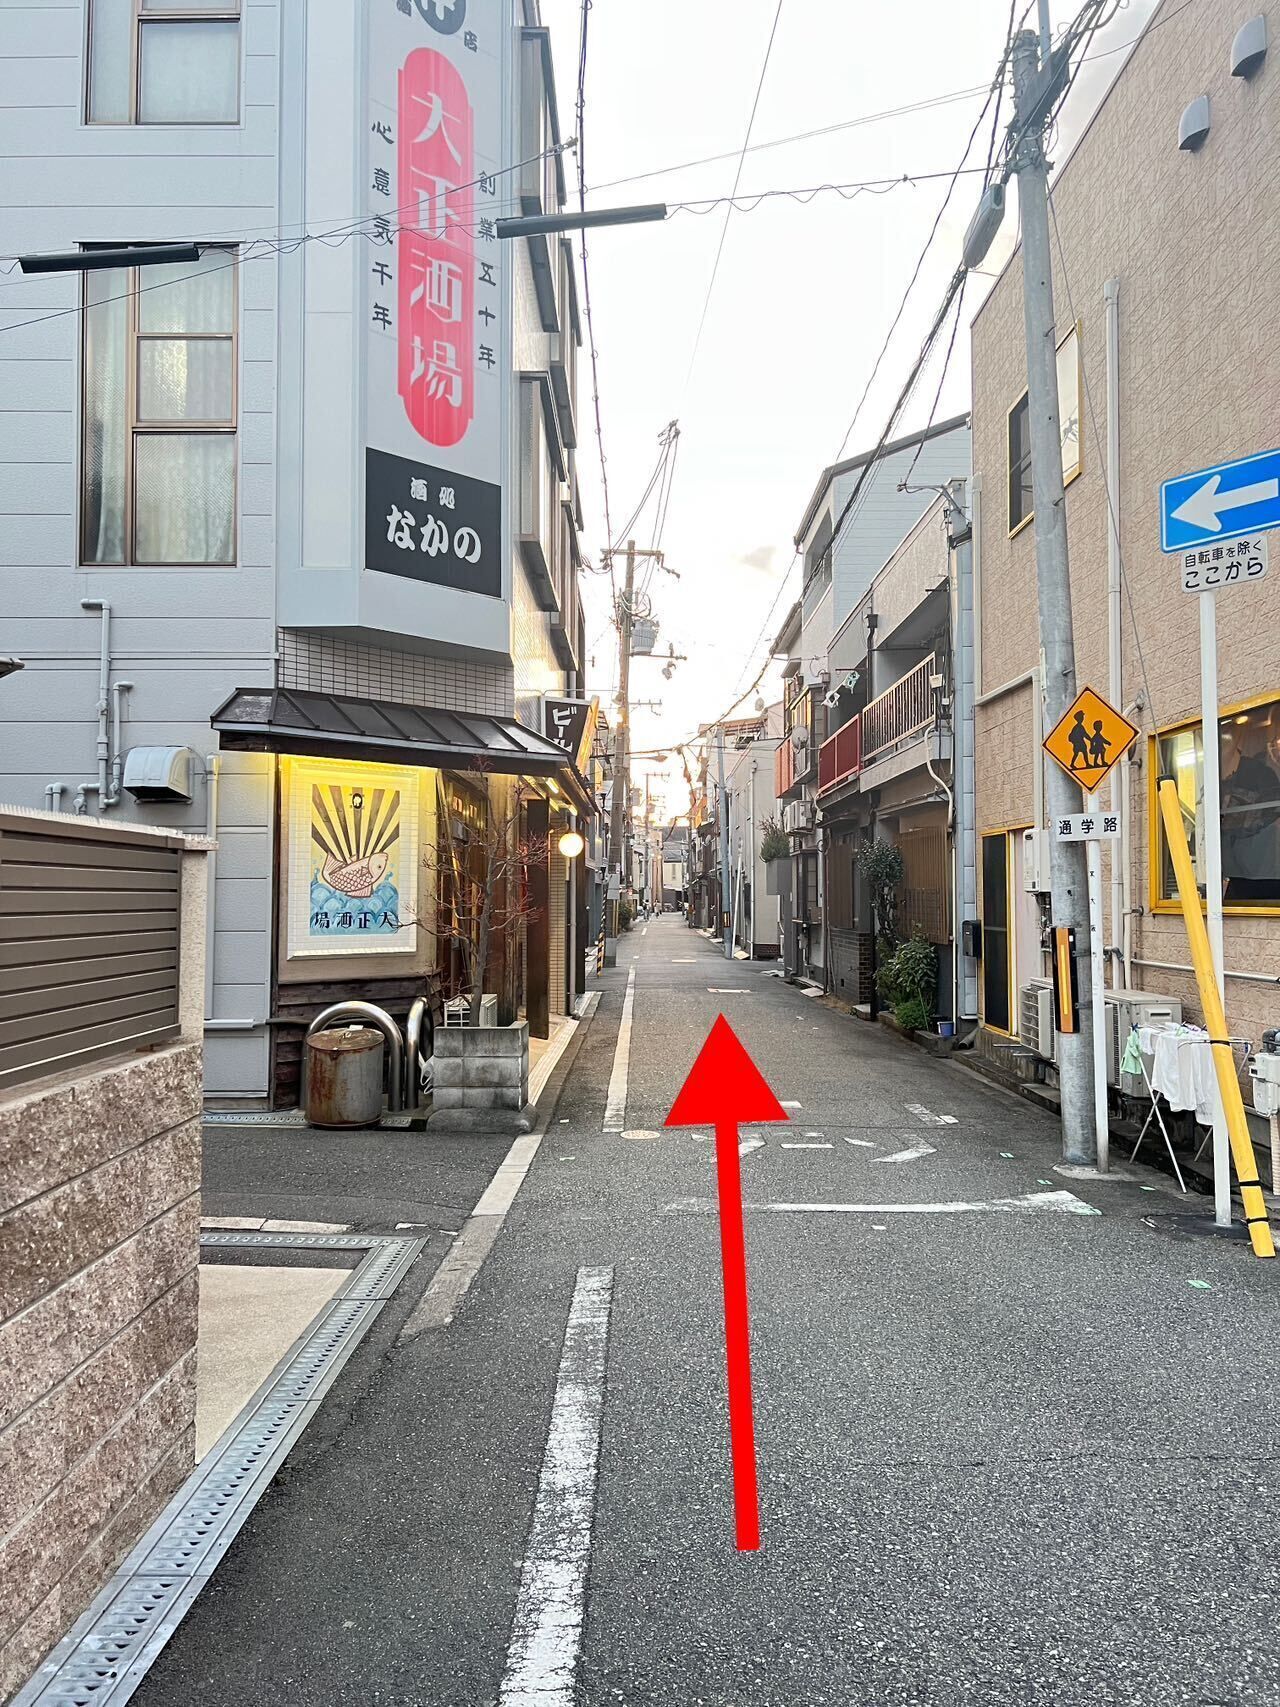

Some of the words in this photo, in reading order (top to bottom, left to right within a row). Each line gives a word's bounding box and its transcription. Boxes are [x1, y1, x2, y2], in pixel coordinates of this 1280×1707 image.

[409, 91, 464, 408] 大正酒場
[477, 170, 496, 370] 創業五十年
[410, 476, 456, 510] 酒処
[386, 504, 482, 564] なかの
[1185, 539, 1263, 568] 自転車を除く
[1185, 556, 1264, 589] ここから
[552, 706, 577, 753] ビール
[1058, 817, 1118, 836] 通学路
